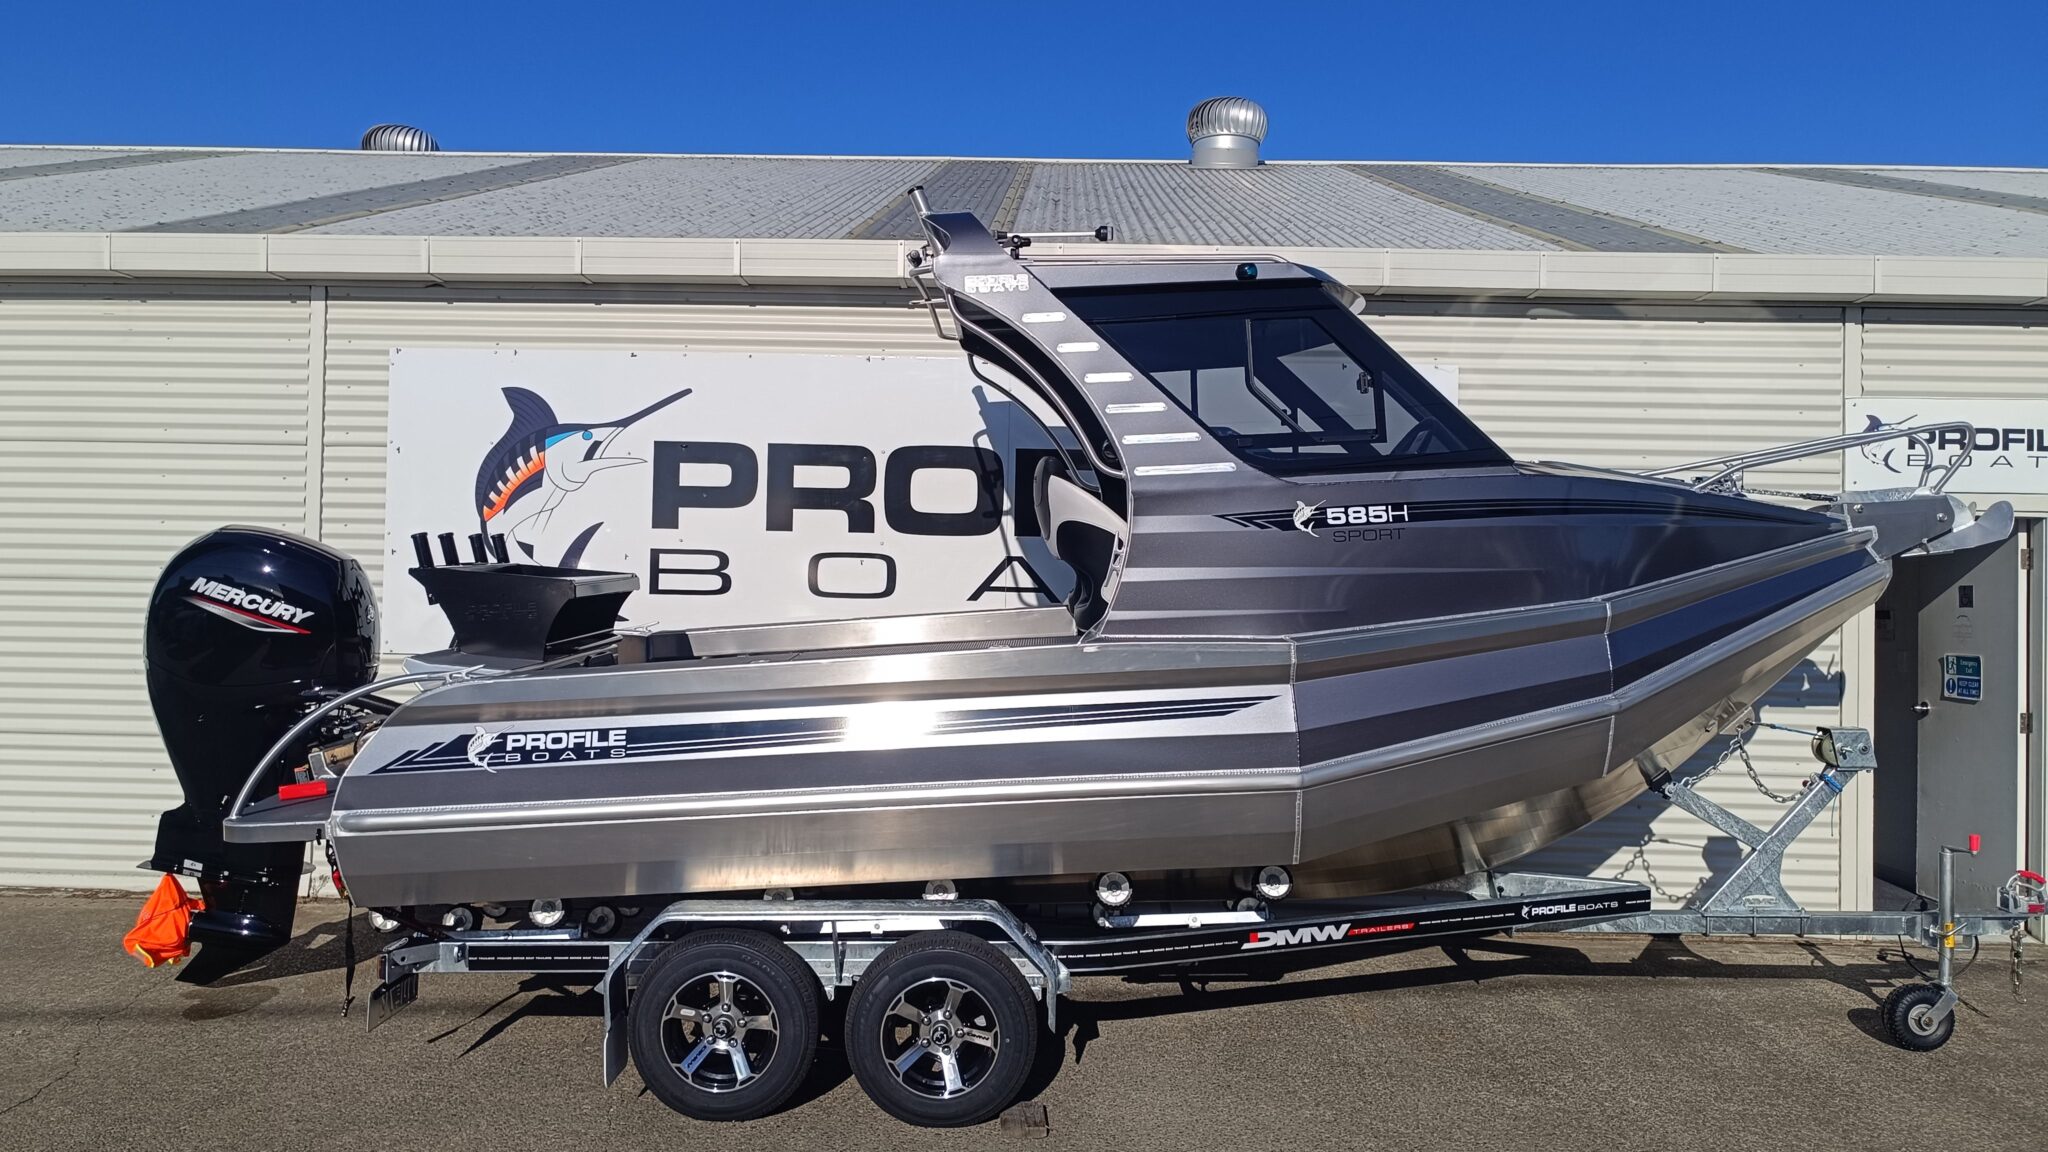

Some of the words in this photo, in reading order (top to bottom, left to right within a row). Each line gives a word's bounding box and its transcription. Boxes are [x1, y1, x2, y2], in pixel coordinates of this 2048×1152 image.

[1326, 504, 1409, 525] 585H
[1333, 527, 1406, 543] SPORT
[190, 577, 315, 624] MERCURY
[506, 729, 627, 751] PROFILE
[505, 748, 626, 763] BOATS
[1531, 903, 1577, 916] PROFILE
[1577, 901, 1619, 912] BOATS
[1241, 923, 1351, 949] DMW
[1354, 924, 1409, 934] TRAILERS
